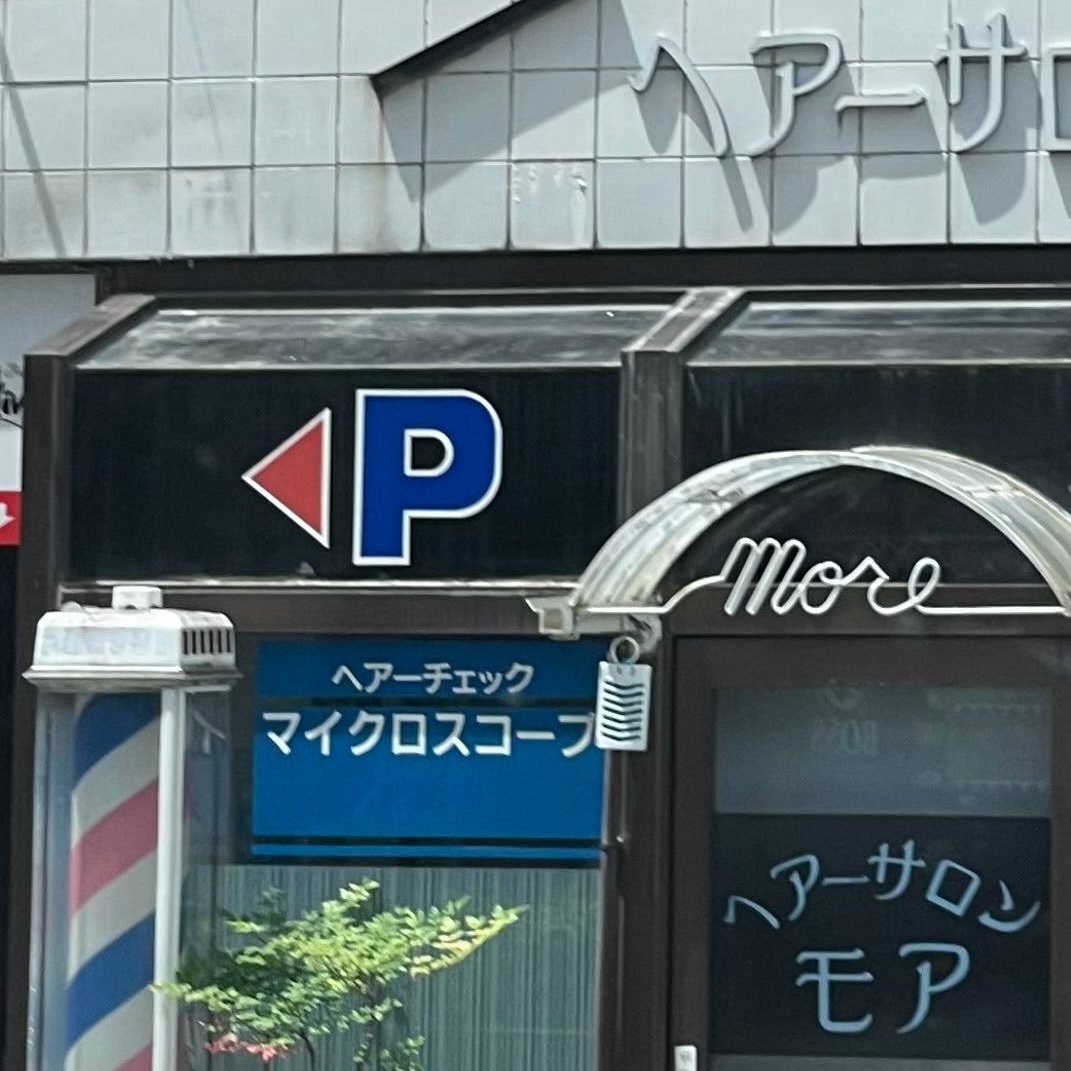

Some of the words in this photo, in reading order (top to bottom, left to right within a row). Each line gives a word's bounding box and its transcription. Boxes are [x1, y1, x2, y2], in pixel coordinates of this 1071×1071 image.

[352, 388, 503, 566] P
[331, 661, 535, 695] ヘアーチェック
[261, 710, 597, 758] マイクロスコープ
[723, 839, 1042, 932] ヘアーサロン
[795, 942, 971, 1033] モア
